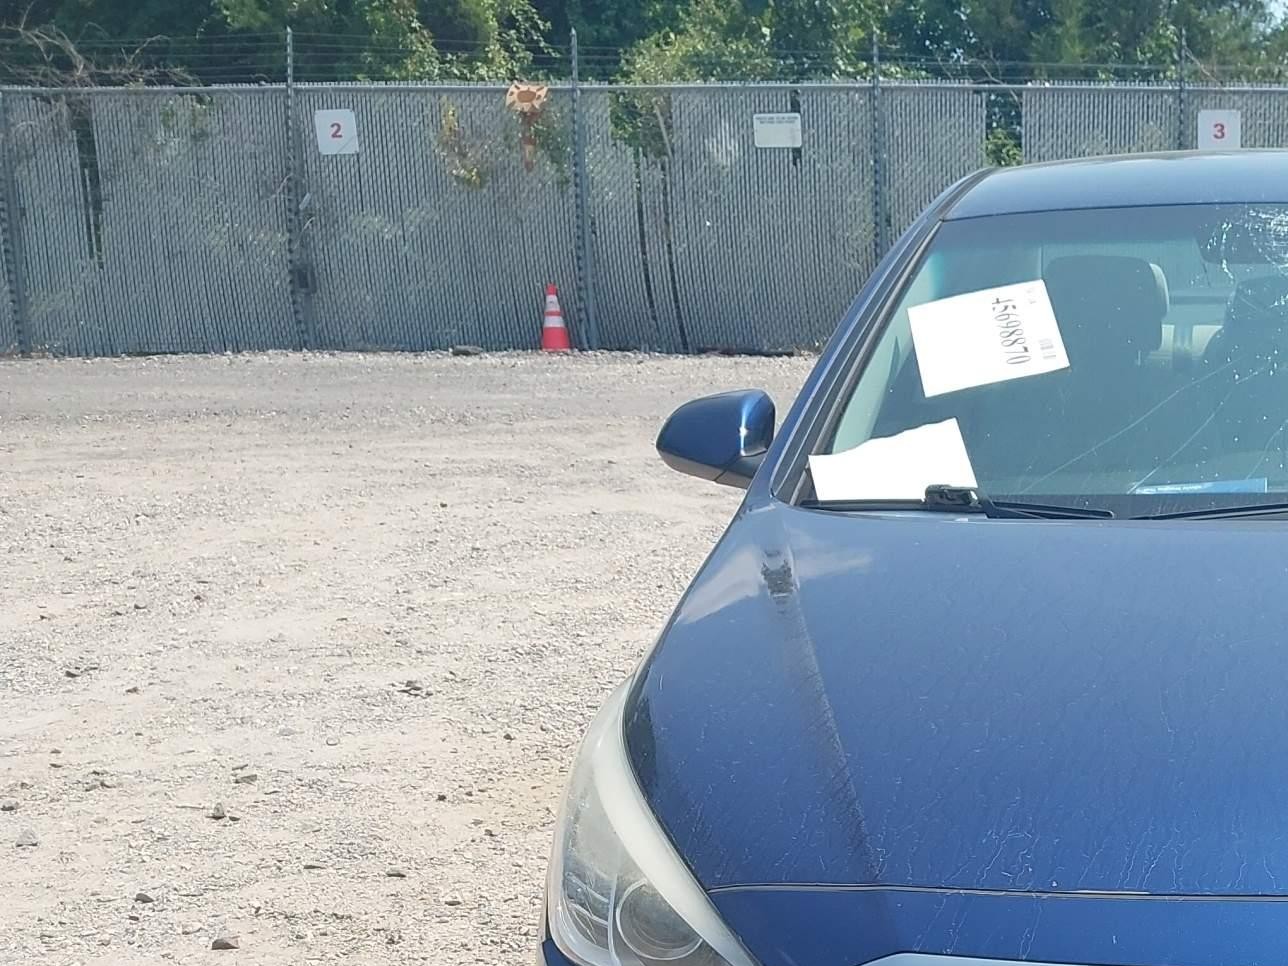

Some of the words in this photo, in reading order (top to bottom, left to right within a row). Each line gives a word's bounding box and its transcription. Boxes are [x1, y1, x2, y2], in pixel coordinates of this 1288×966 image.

[330, 122, 343, 139] 2
[1213, 122, 1225, 140] 3
[991, 297, 1032, 365] 45698870
